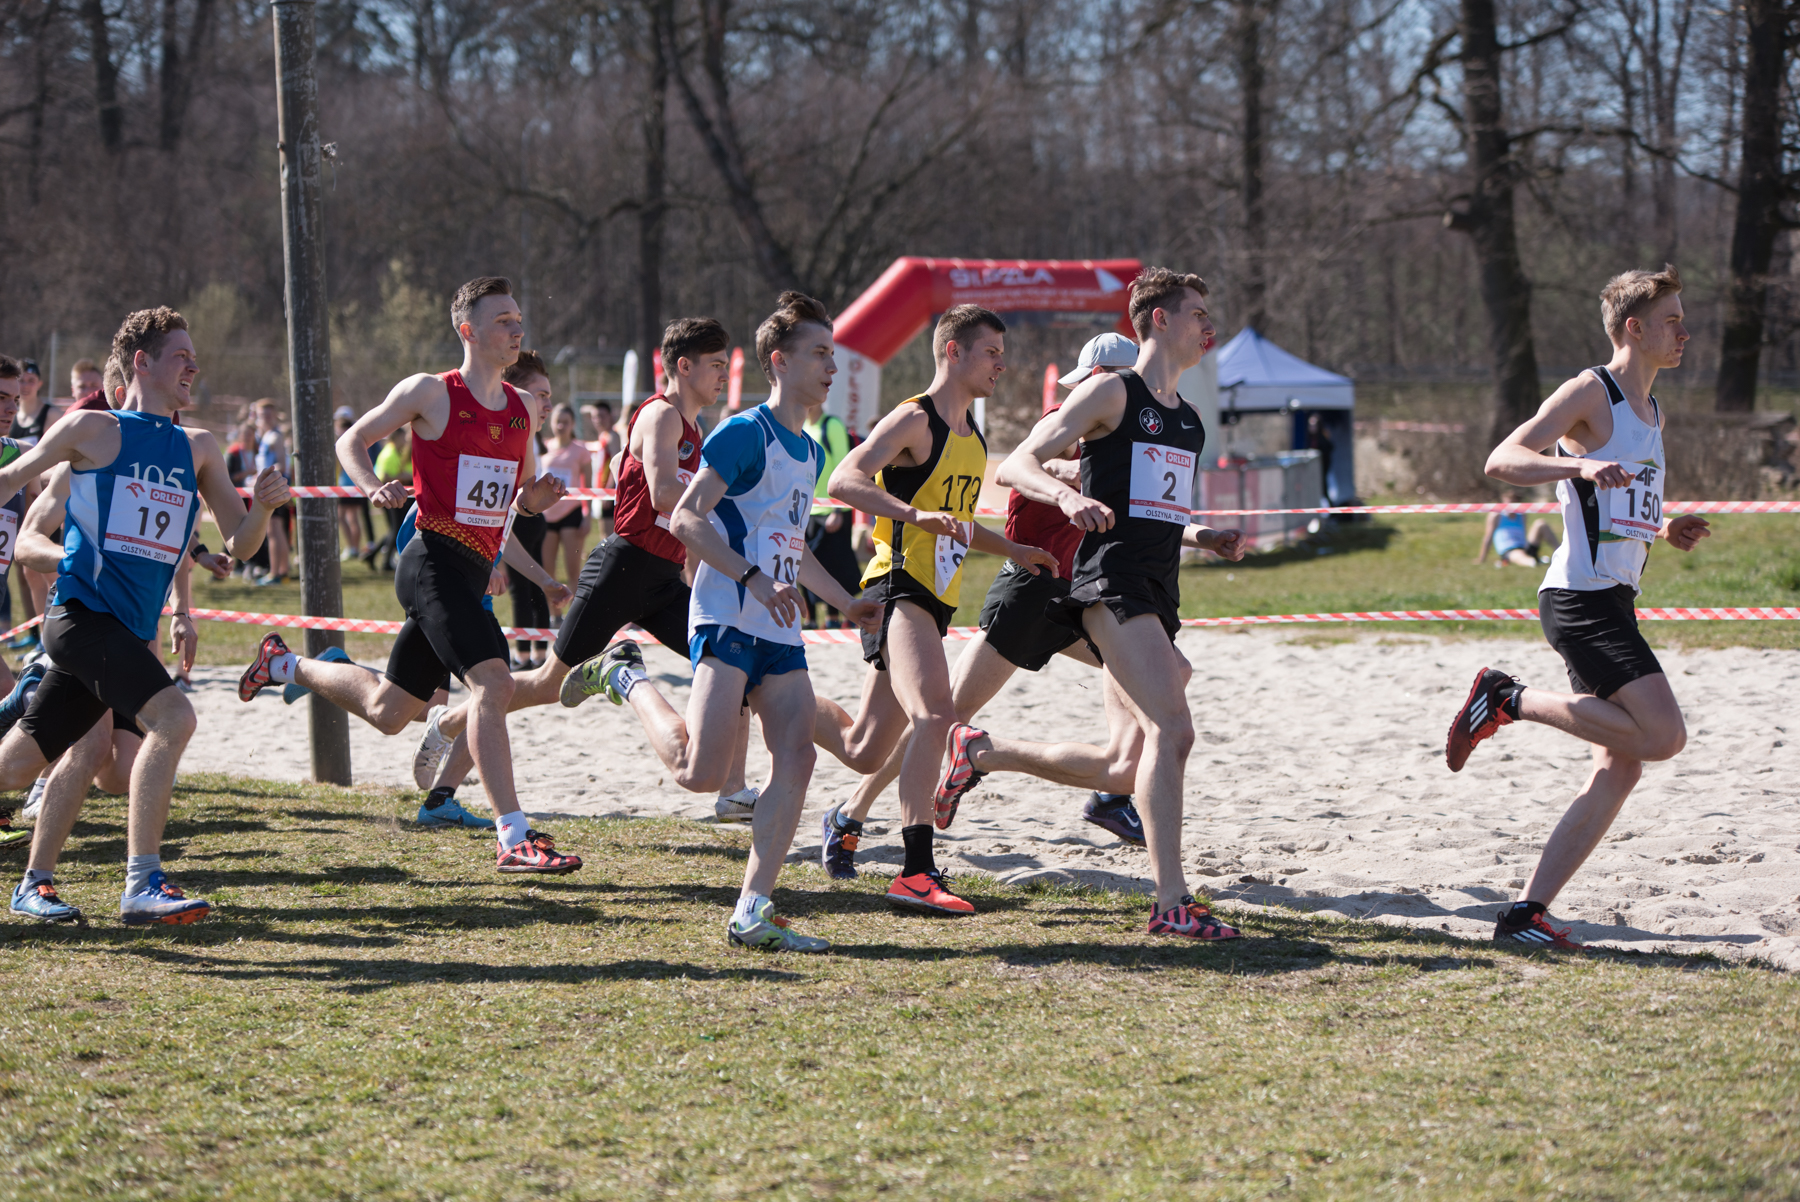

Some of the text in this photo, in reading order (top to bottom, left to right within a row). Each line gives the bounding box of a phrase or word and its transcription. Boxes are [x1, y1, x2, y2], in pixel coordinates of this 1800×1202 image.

[1167, 454, 1190, 467] ORLEN
[1161, 471, 1177, 502] 2
[152, 490, 184, 506] ORLEN
[467, 480, 509, 510] 431
[788, 488, 808, 529] 37
[1625, 488, 1660, 524] 150
[467, 516, 490, 525] OLSZYNA
[1145, 509, 1172, 520] OLSZYNA
[138, 506, 171, 540] 19
[1625, 529, 1649, 540] OLSZYNA
[121, 545, 167, 561] OLSZYNA 2019
